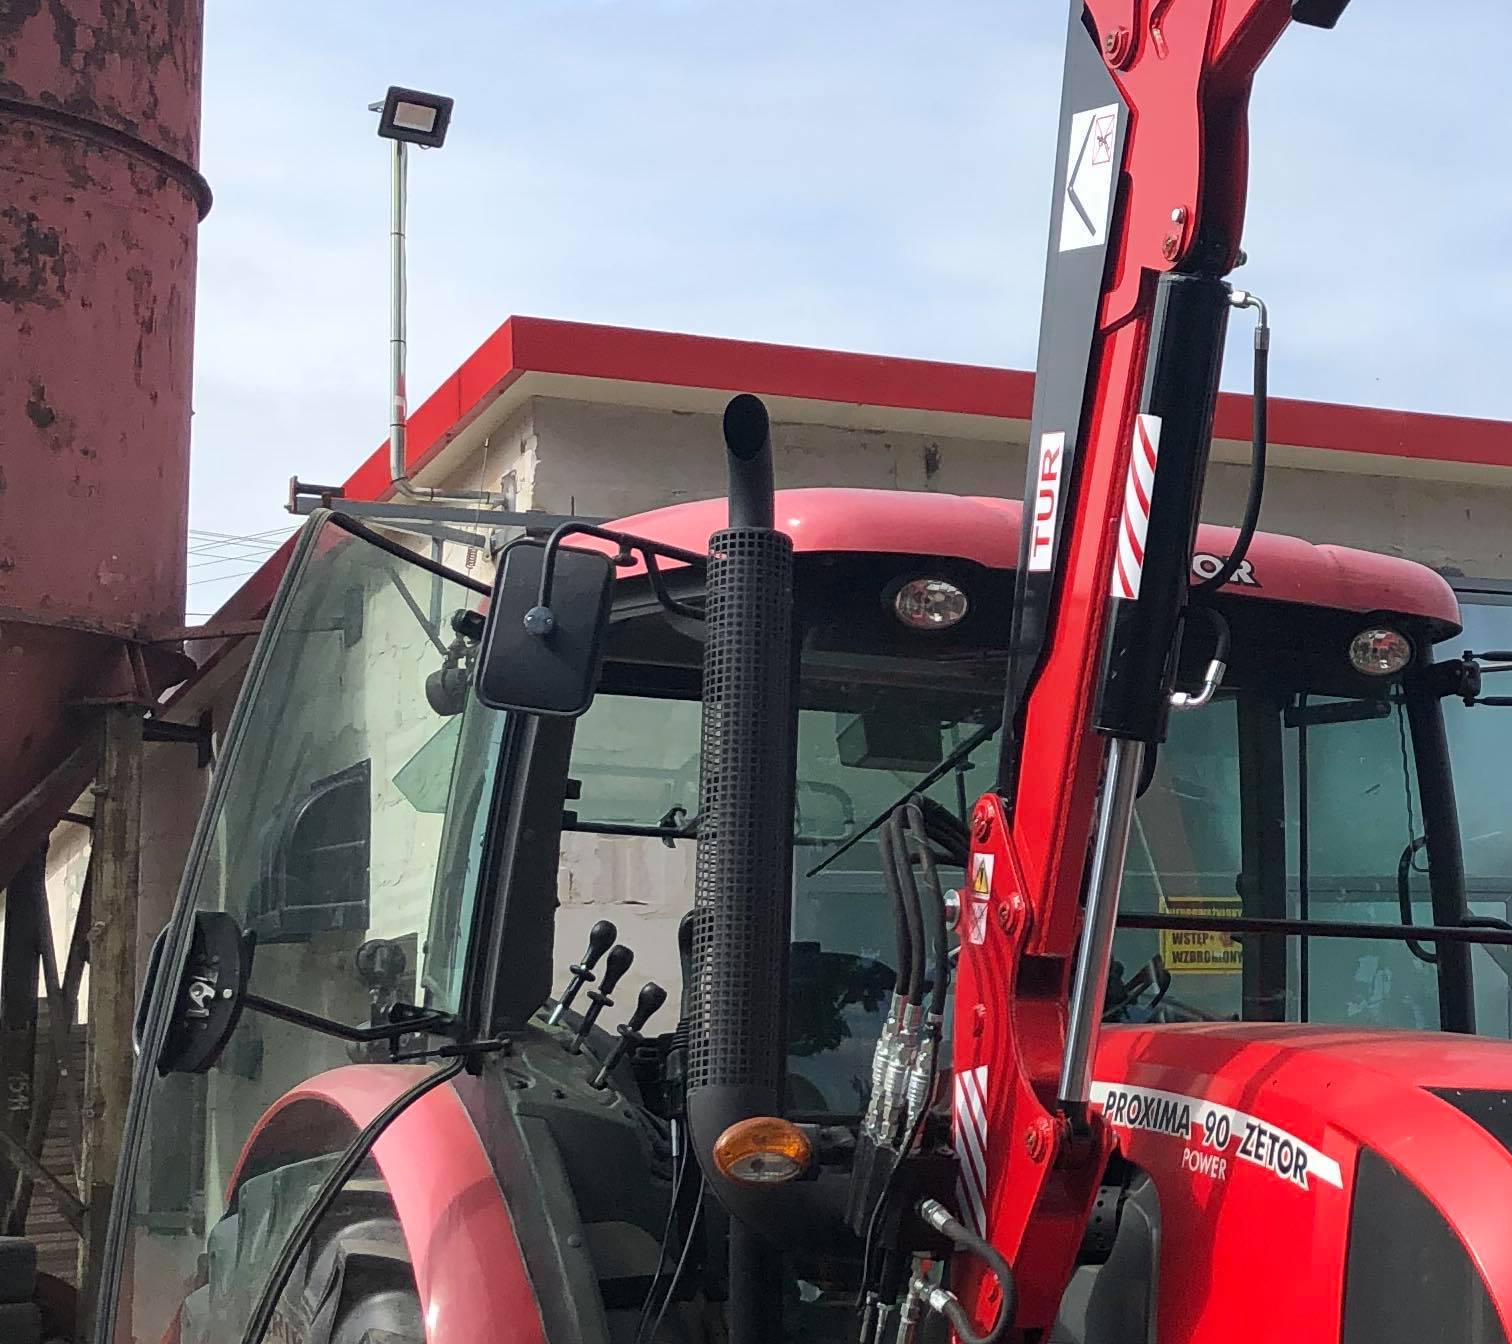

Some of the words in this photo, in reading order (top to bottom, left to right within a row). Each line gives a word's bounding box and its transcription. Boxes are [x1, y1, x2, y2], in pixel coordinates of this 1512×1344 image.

[1034, 447, 1061, 557] TUR
[1104, 1090, 1191, 1138] PROXIMA
[1203, 1109, 1231, 1150] 90
[1238, 1121, 1308, 1188] ZETOR
[1182, 1148, 1227, 1180] POWER
